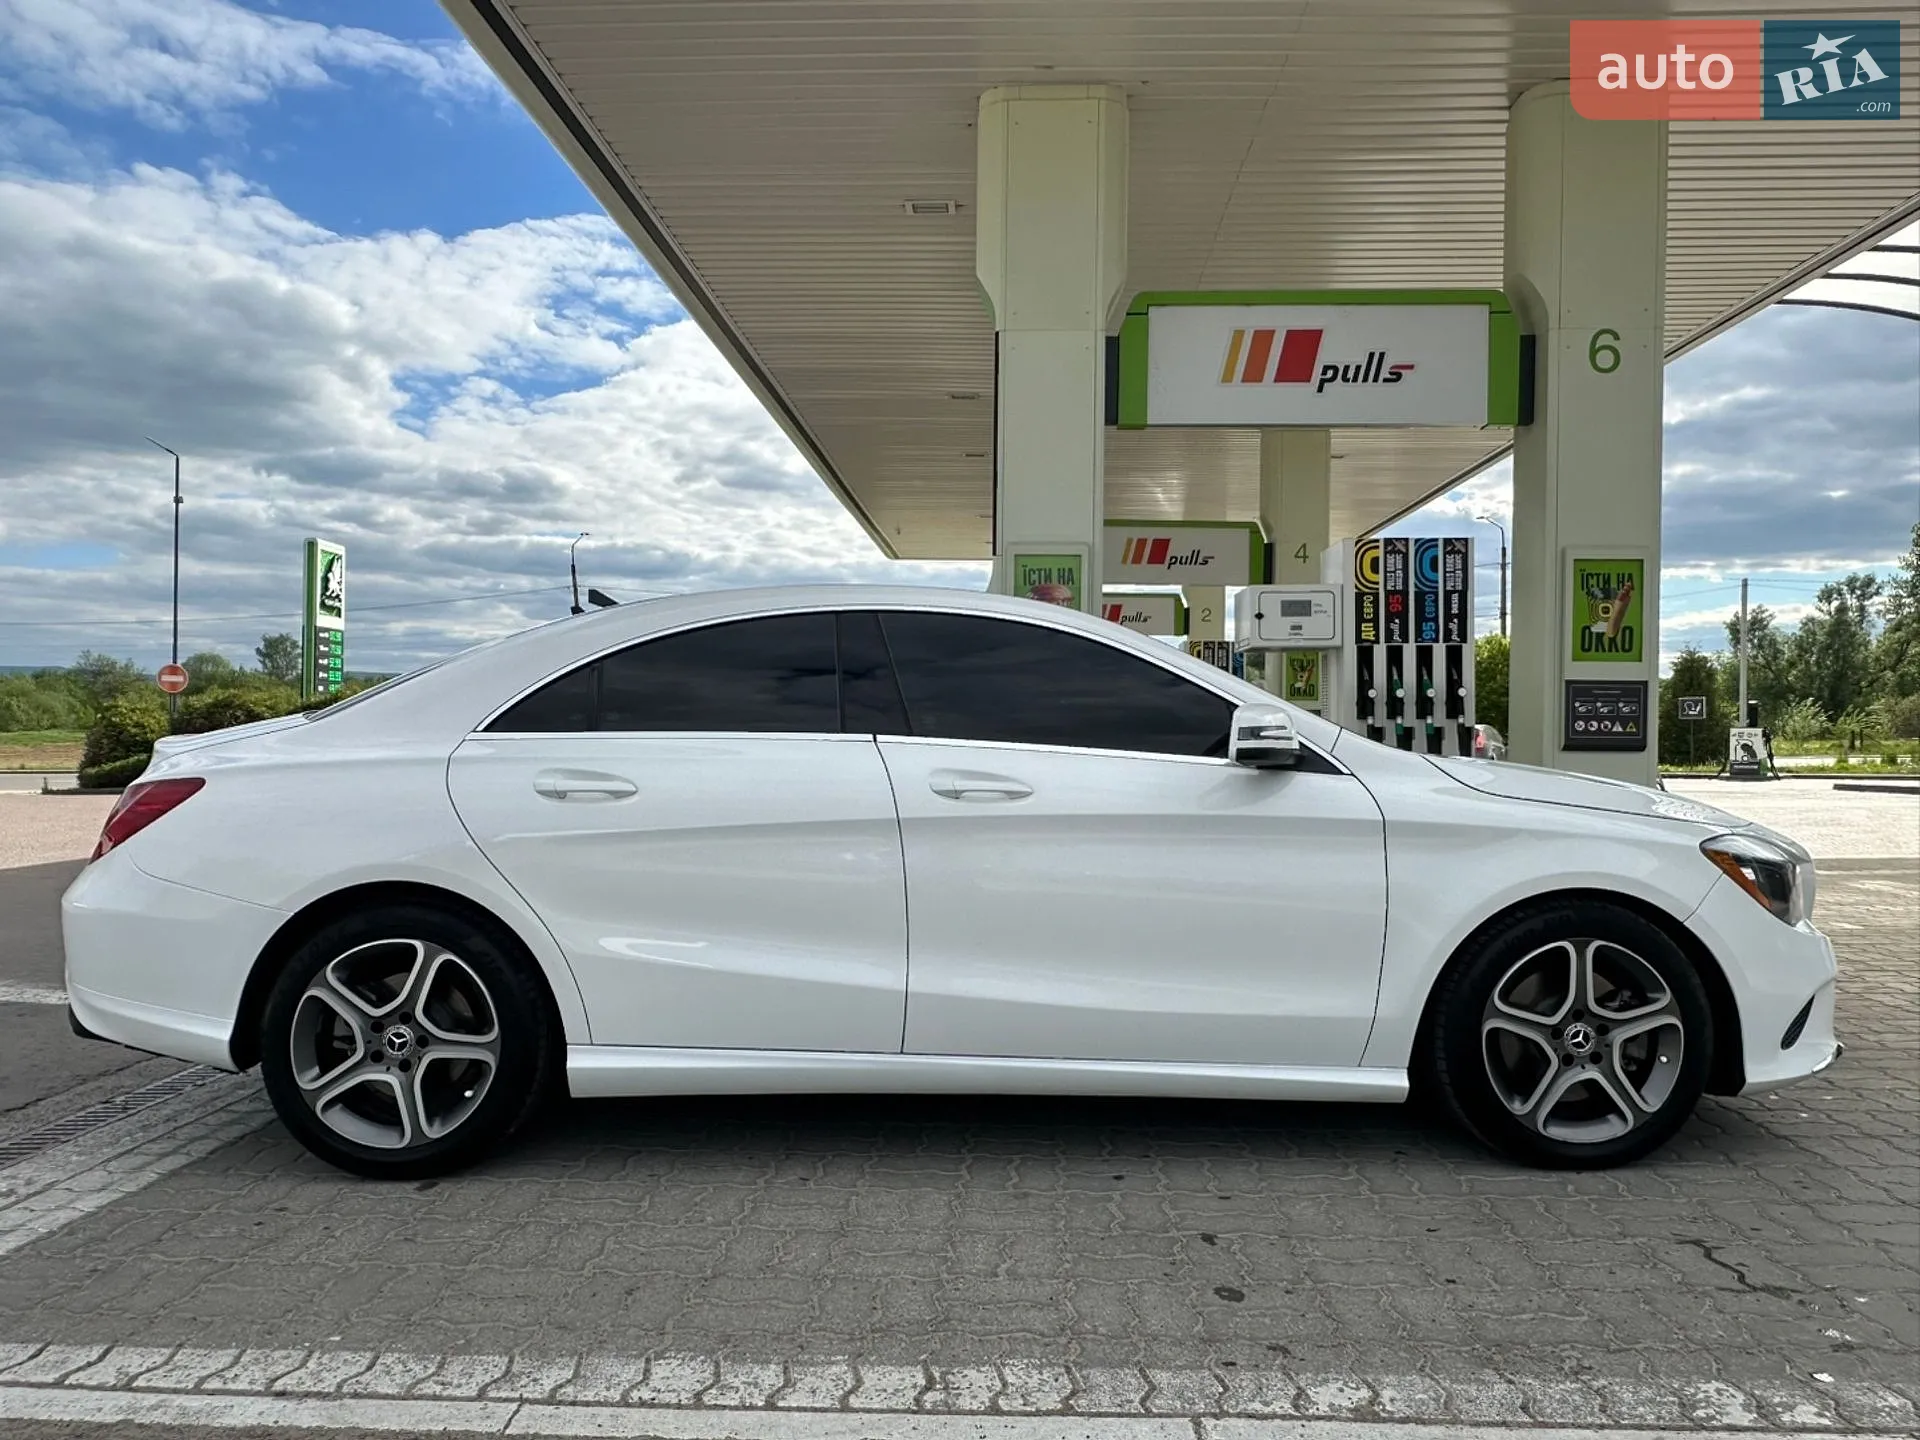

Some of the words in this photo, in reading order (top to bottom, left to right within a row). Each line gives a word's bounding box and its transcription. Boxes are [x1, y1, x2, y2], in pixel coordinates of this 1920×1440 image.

[1588, 328, 1622, 374] 6
[1316, 351, 1415, 393] pulls
[1167, 549, 1215, 569] pulls
[1294, 543, 1309, 564] 4
[1021, 564, 1052, 586] ЇСТИ
[1057, 567, 1075, 586] НА
[1580, 568, 1611, 593] ЇСТИ
[1389, 594, 1402, 612] 95
[1201, 607, 1212, 622] 2
[1361, 622, 1376, 640] ДП
[1422, 622, 1435, 639] 95
